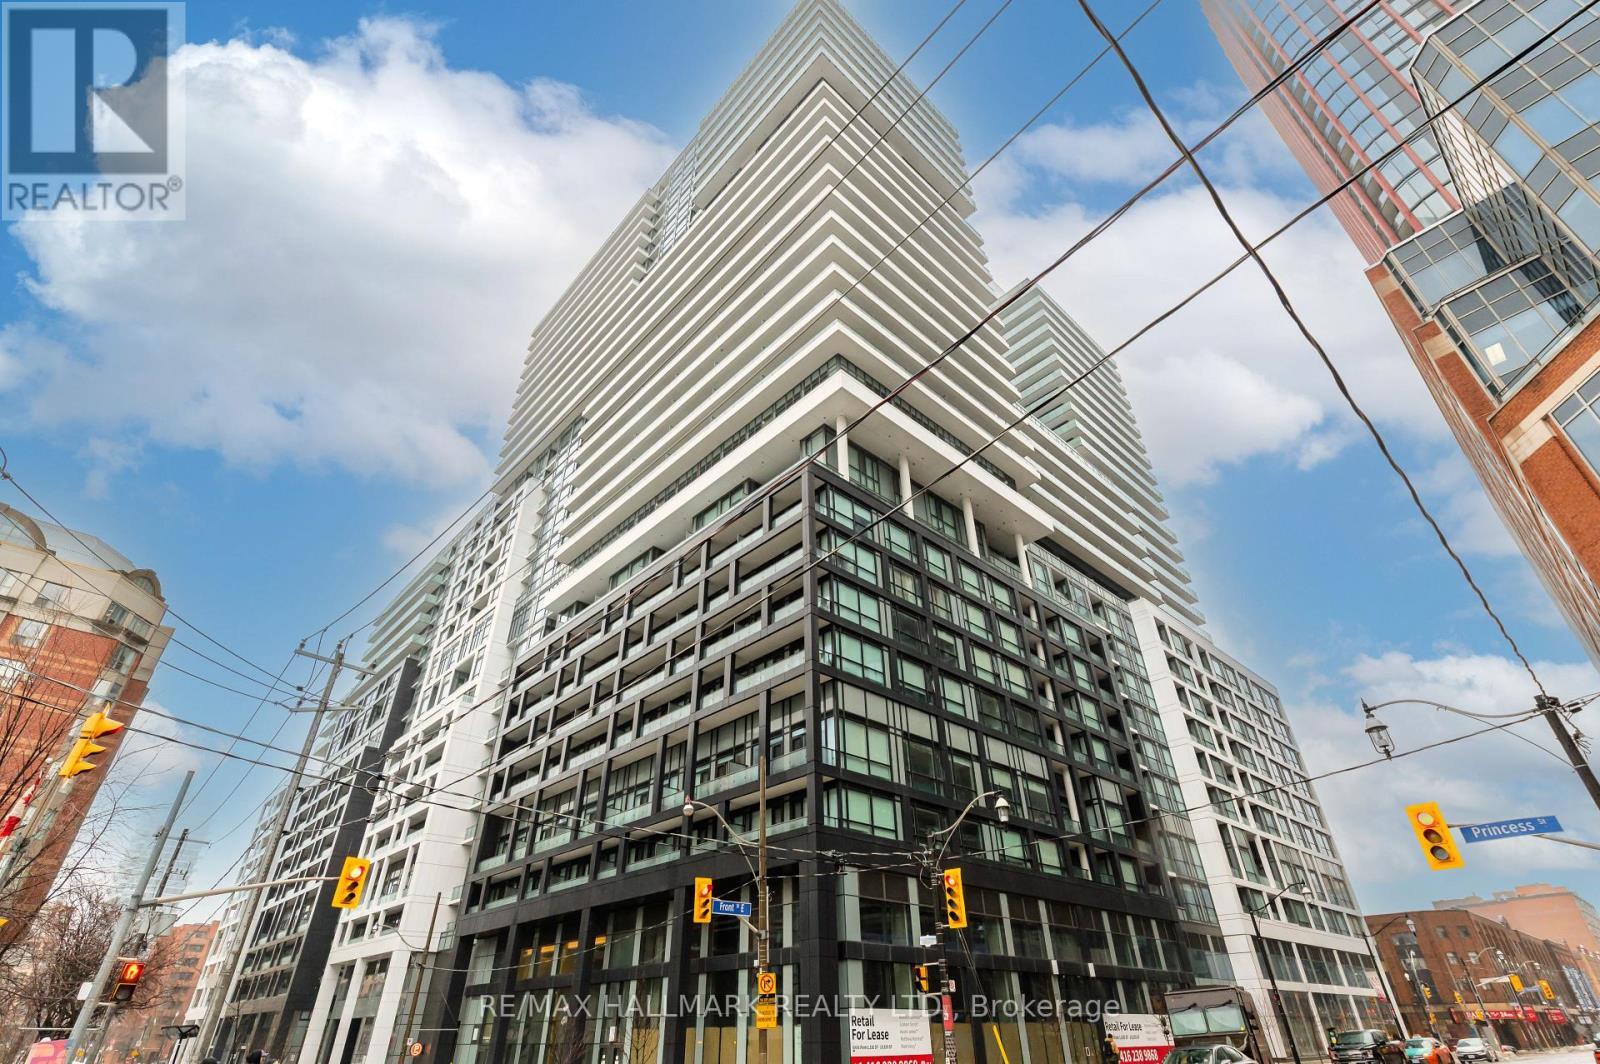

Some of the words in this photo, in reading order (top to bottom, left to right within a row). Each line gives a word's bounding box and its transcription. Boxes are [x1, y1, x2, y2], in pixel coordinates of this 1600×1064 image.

[1472, 822, 1535, 838] Princess
[720, 902, 735, 912] Front
[851, 1015, 875, 1027] Retail
[1105, 1021, 1119, 1031] Retail
[1120, 1021, 1128, 1031] For
[1128, 1022, 1142, 1031] Lease
[851, 1029, 865, 1040] For
[867, 1029, 889, 1040] Lease
[1120, 1049, 1132, 1062] 416
[1132, 1049, 1144, 1062] 238
